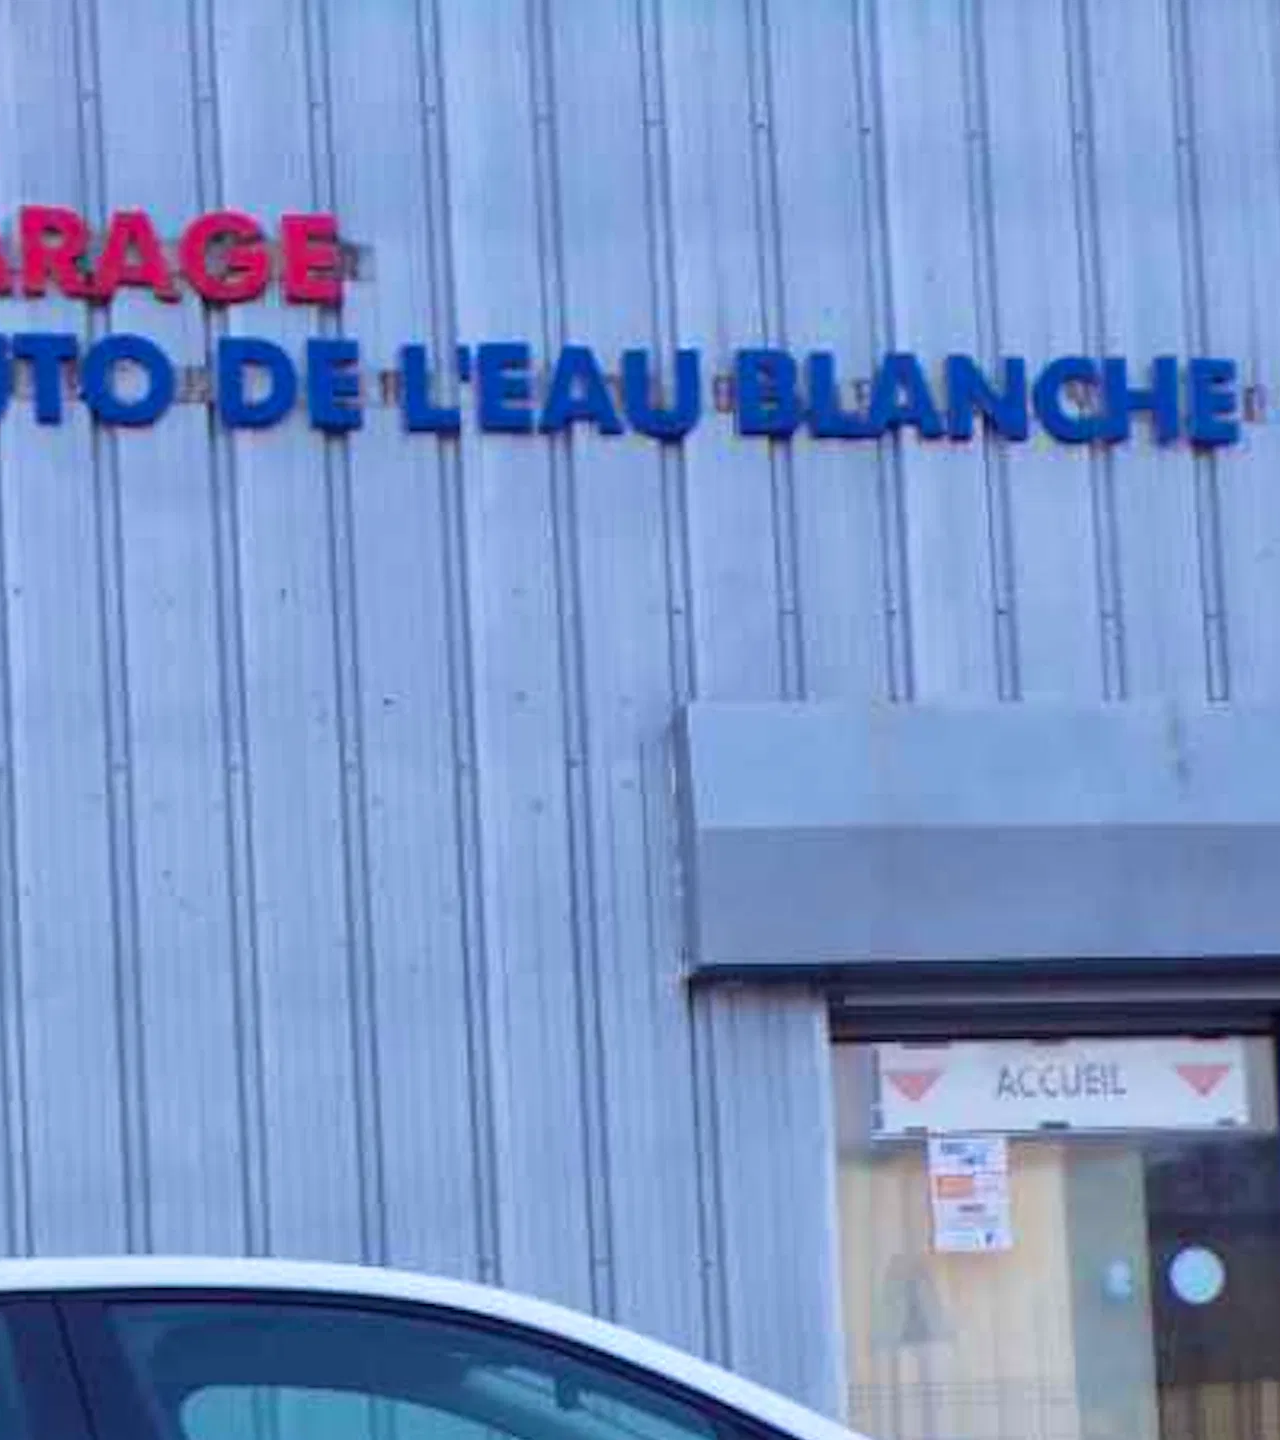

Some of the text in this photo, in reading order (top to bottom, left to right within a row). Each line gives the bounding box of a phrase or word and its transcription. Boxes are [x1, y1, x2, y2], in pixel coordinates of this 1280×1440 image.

[219, 334, 363, 434] DE
[400, 341, 701, 441] L'EAU
[732, 347, 1239, 448] BLANCHE
[995, 1061, 1128, 1100] ACCUEIL
